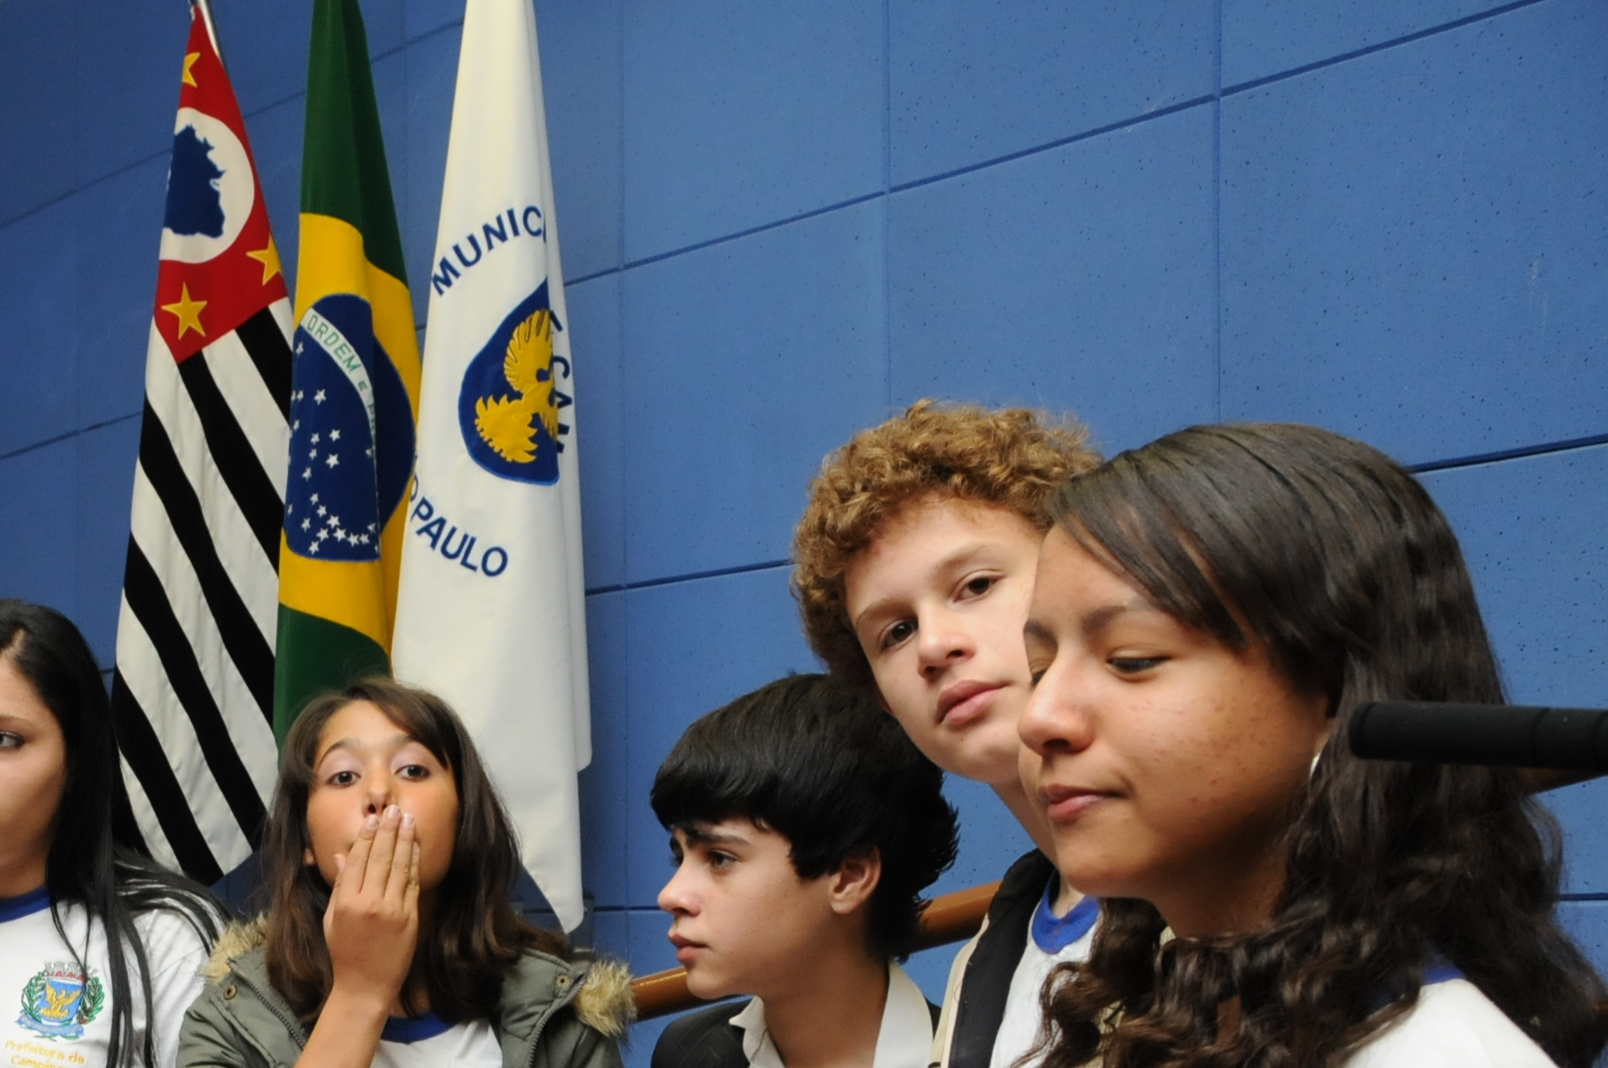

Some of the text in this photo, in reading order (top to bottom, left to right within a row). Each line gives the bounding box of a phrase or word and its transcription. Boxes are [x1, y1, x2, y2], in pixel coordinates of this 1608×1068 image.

[431, 205, 547, 296] MUNIC
[307, 314, 368, 391] ORDEM E
[410, 496, 508, 577] PAULO
[4, 1040, 65, 1060] Prefeitura
